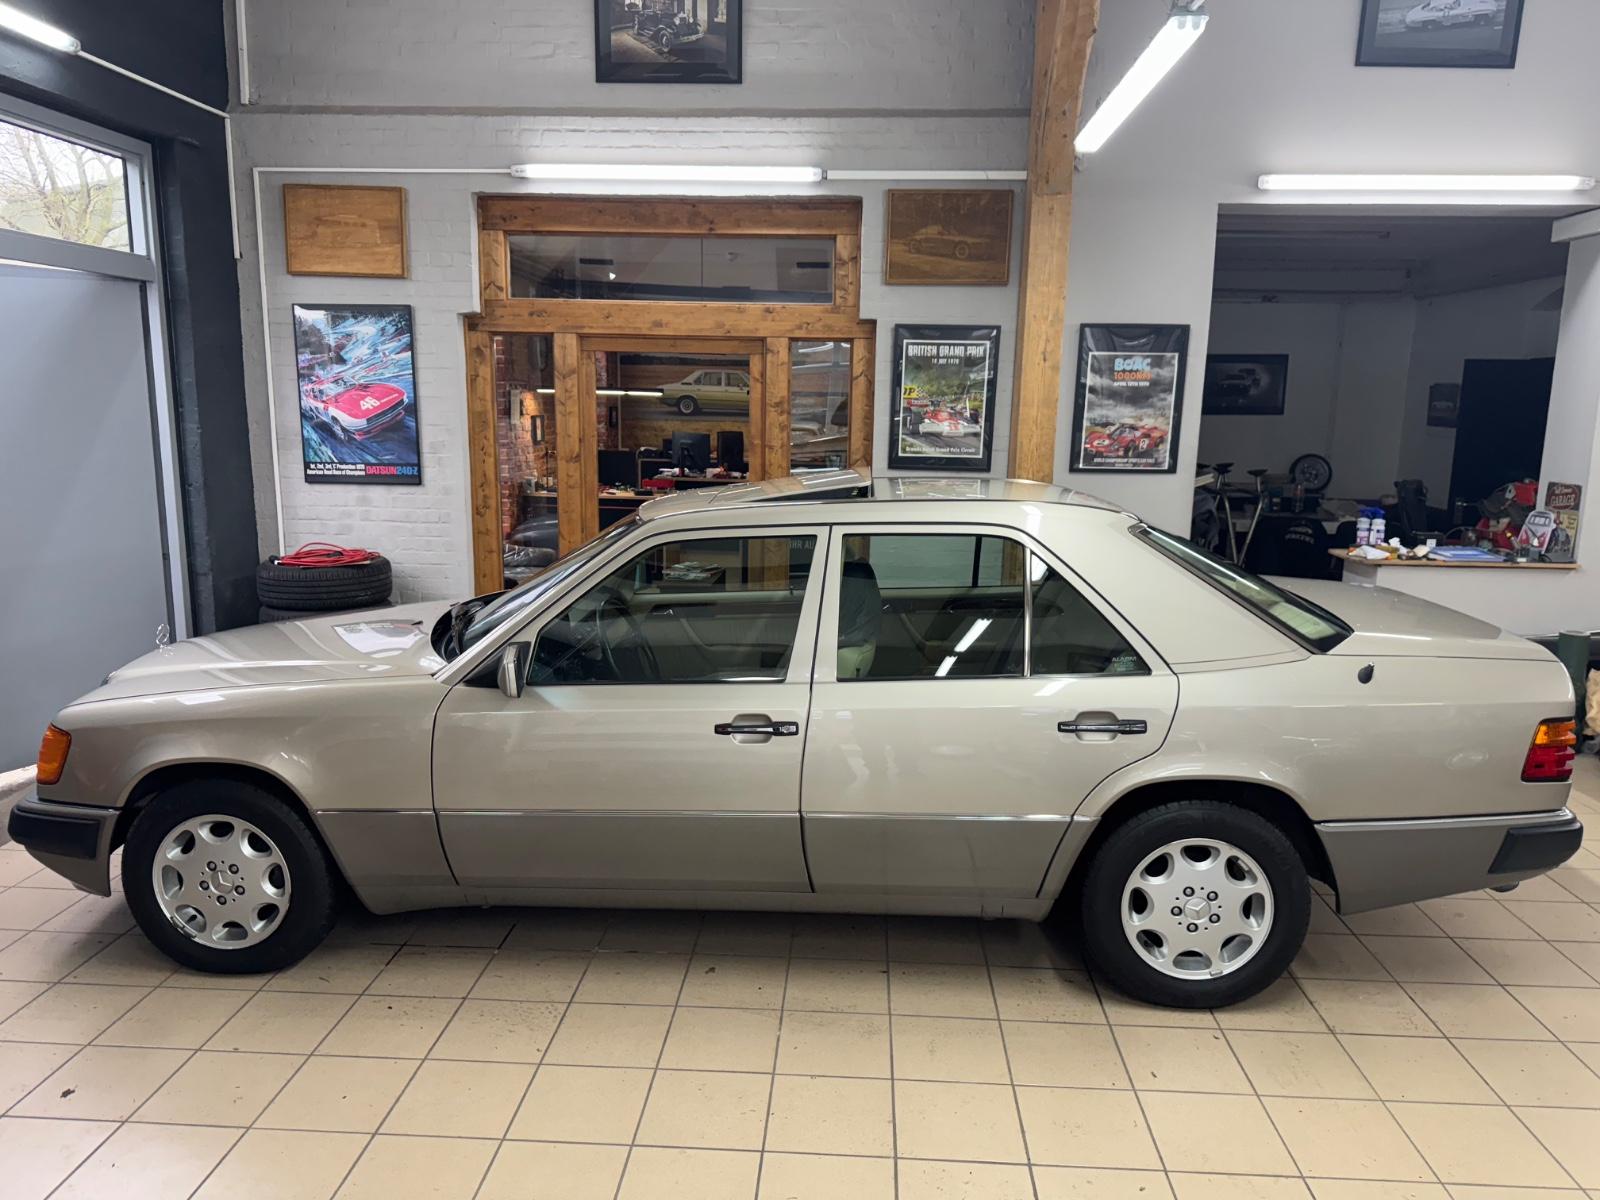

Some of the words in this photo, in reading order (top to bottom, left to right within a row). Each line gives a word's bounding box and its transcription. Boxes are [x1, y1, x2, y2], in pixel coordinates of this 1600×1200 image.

[908, 345, 937, 357] BRITISH
[939, 345, 965, 358] GRAND
[966, 345, 985, 358] PRIX
[1114, 356, 1152, 371] BOAC
[359, 396, 381, 411] 46
[1141, 440, 1146, 450] 2
[366, 465, 397, 475] DATSUN
[1551, 495, 1575, 506] GARAGE
